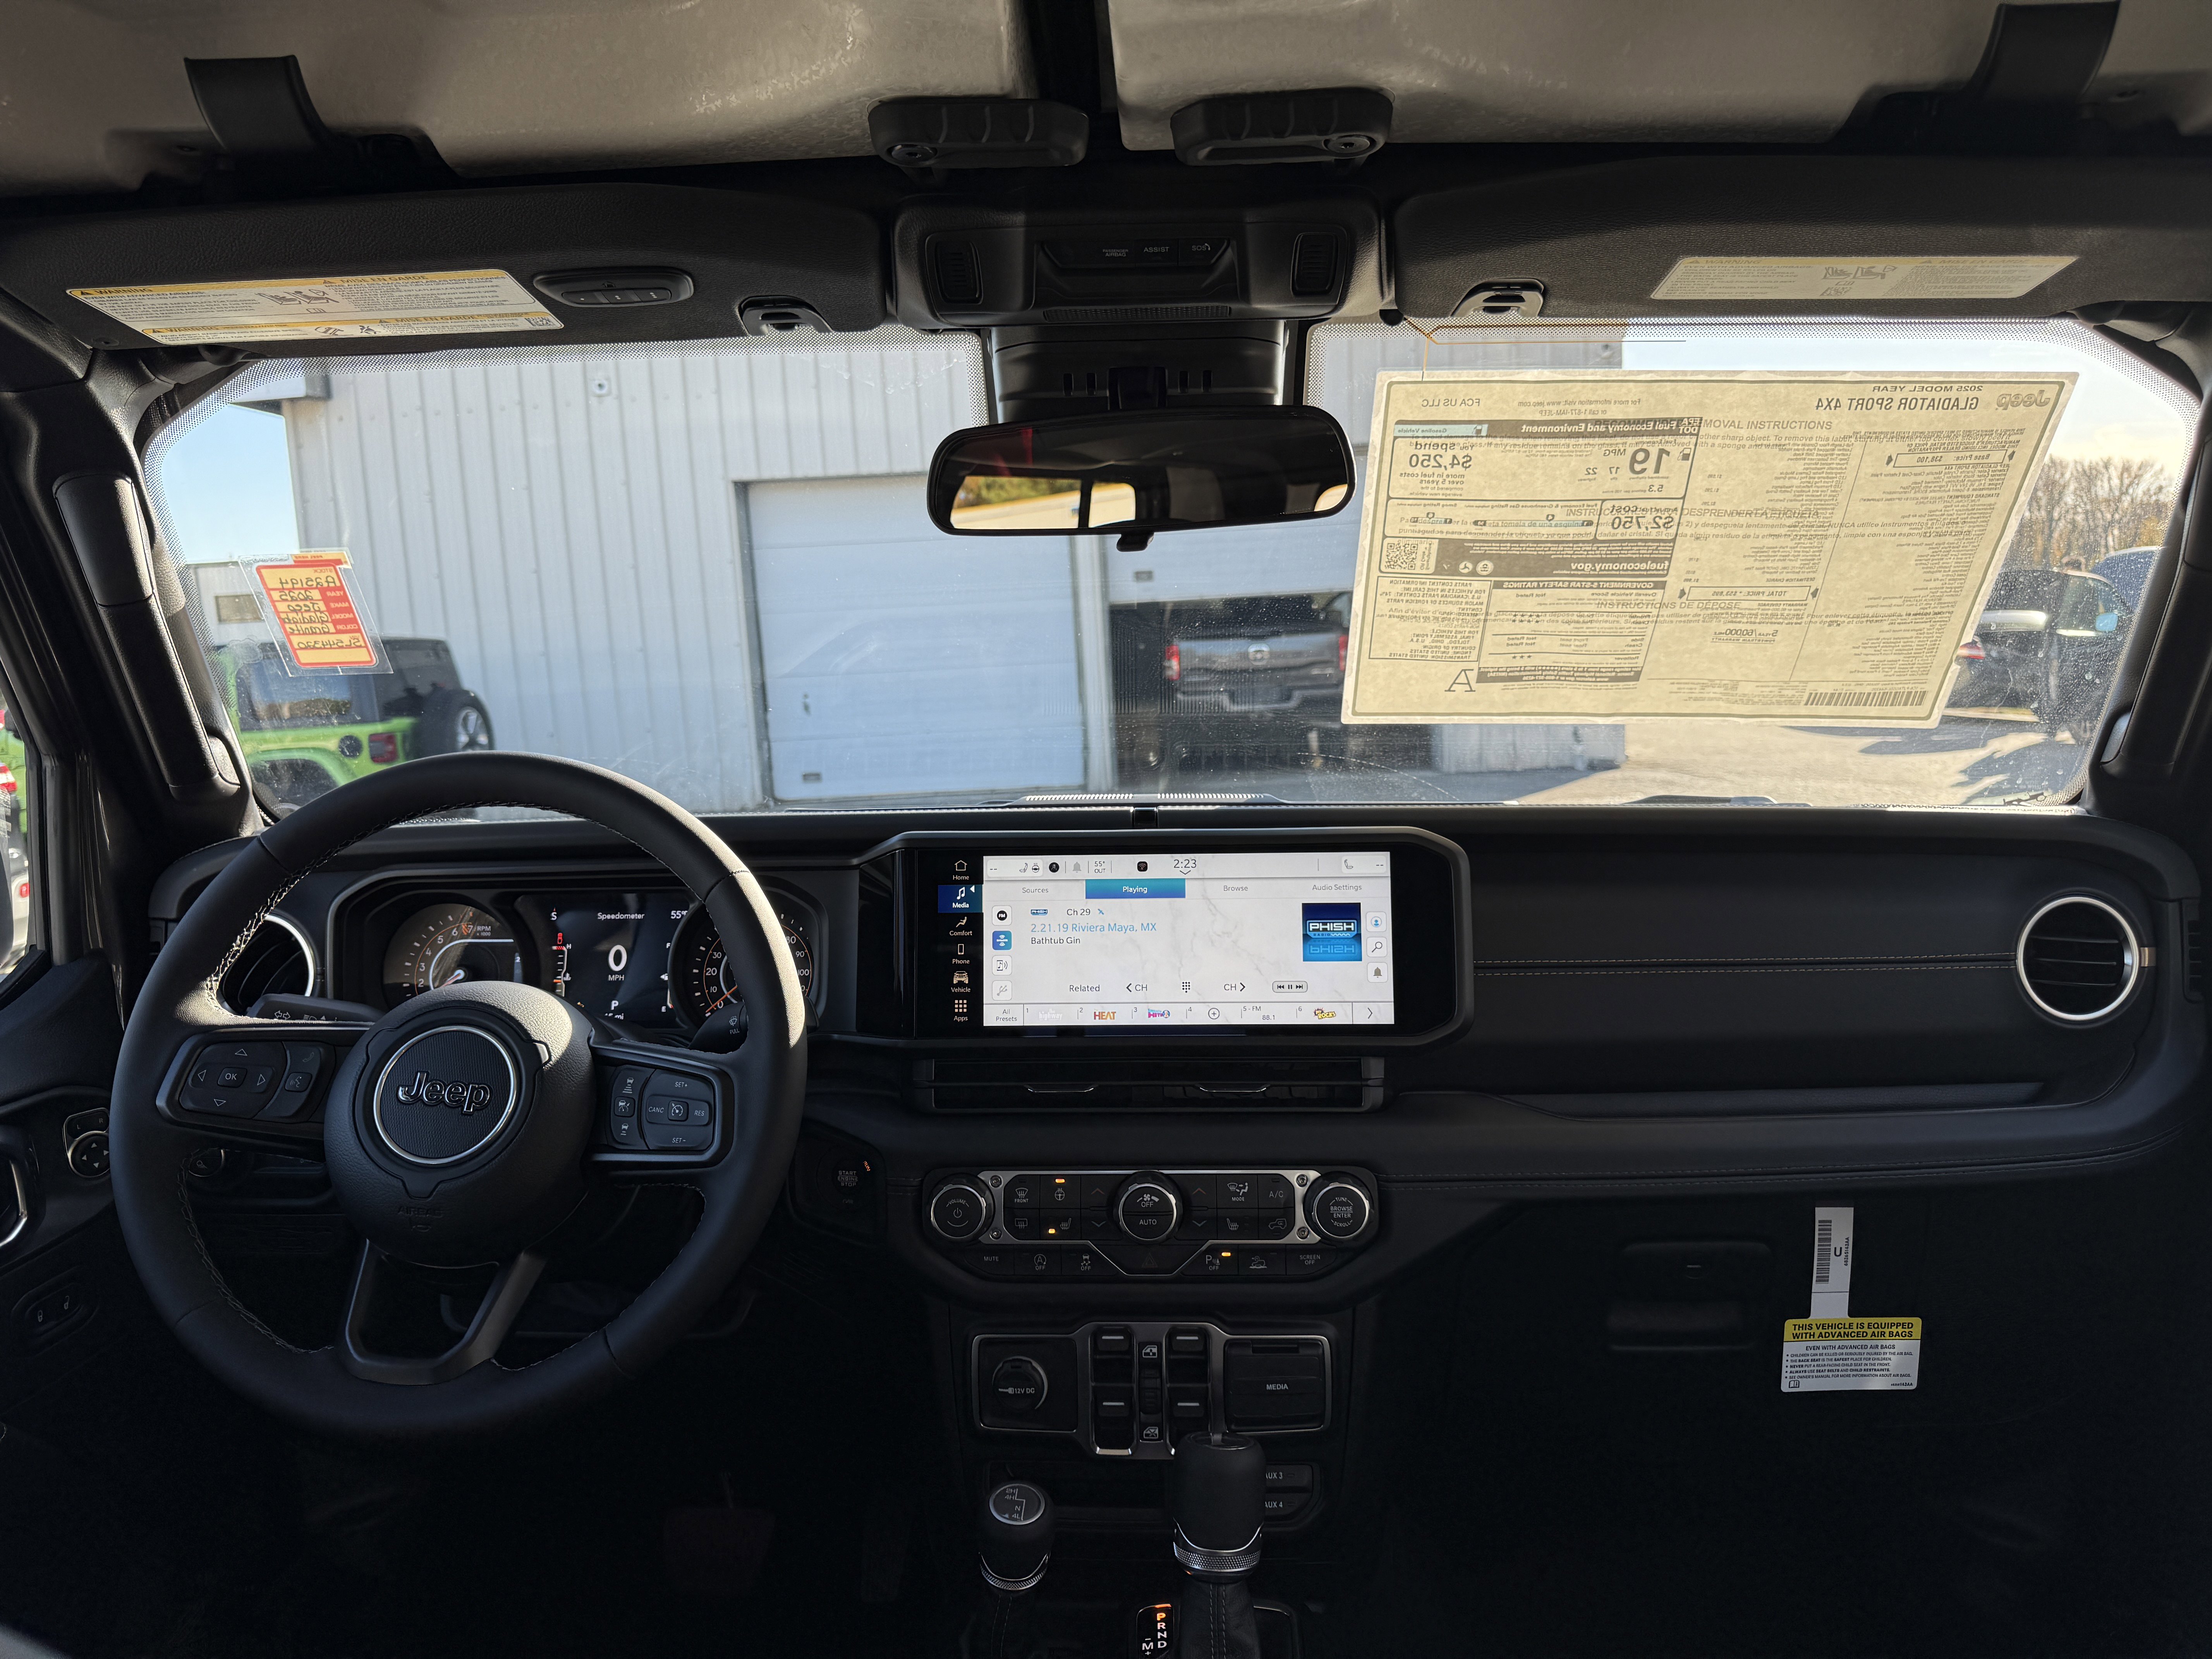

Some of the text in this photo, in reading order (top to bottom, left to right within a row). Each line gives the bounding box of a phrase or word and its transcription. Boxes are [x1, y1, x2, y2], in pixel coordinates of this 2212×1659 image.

[1747, 421, 1832, 430] INSTRUCTIONS
[1697, 600, 1741, 609] DÉPOSE
[1173, 859, 1197, 869] 2:23
[597, 912, 645, 921] Speedometer
[1031, 922, 1156, 934] 2.21.19 Riviera Maya, MX
[1309, 922, 1354, 932] PHISH
[608, 945, 627, 972] 0
[611, 1000, 619, 1010] P
[1094, 1011, 1116, 1020] HEAT
[225, 1072, 237, 1081] OK
[397, 1071, 494, 1116] Jeep
[1269, 1190, 1284, 1199] A/C
[1834, 1247, 1843, 1257] U
[1792, 1323, 1813, 1331] THIS
[1815, 1322, 1853, 1330] VEHICLE
